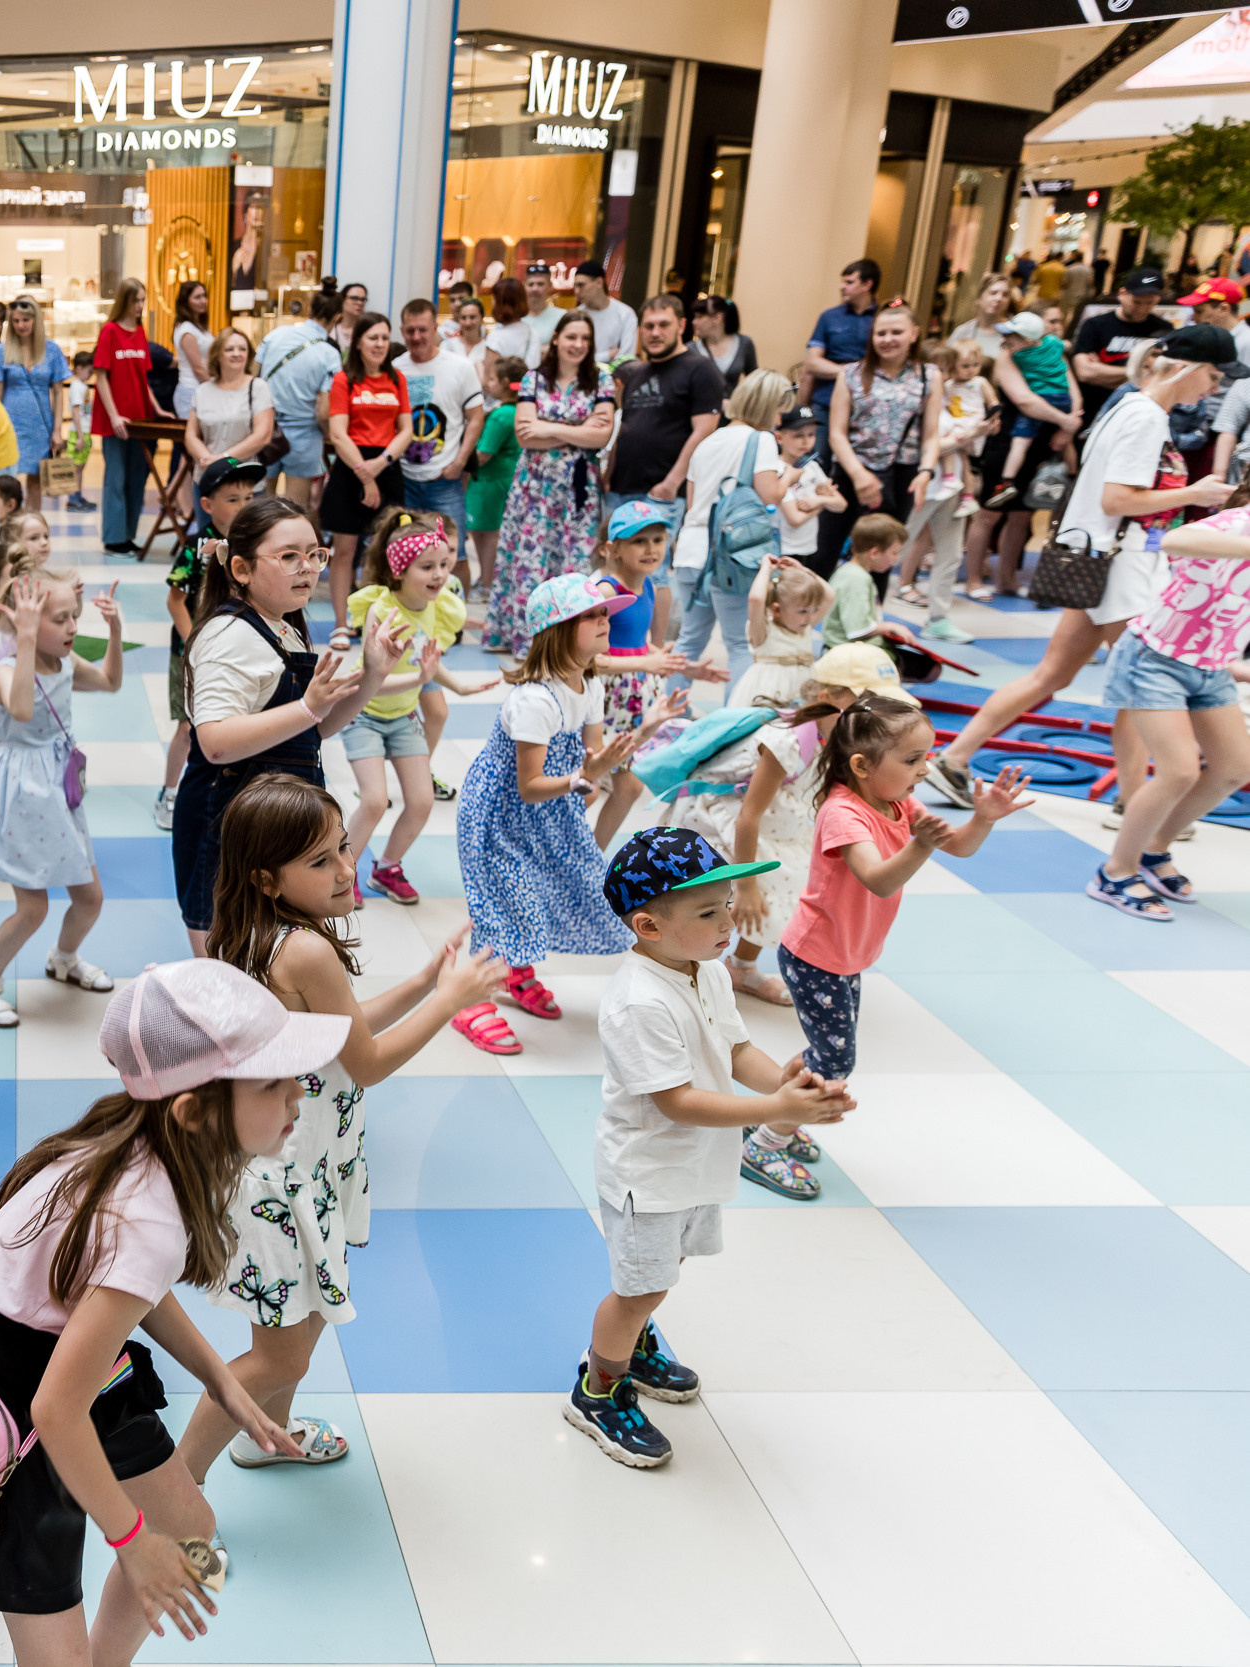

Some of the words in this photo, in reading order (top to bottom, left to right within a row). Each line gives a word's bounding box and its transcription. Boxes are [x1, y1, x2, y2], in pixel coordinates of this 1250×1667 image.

[73, 56, 264, 123] MIUZ
[527, 52, 628, 121] MIUZ
[96, 127, 237, 152] DIAMONDS
[536, 123, 609, 150] DIAMONDS
